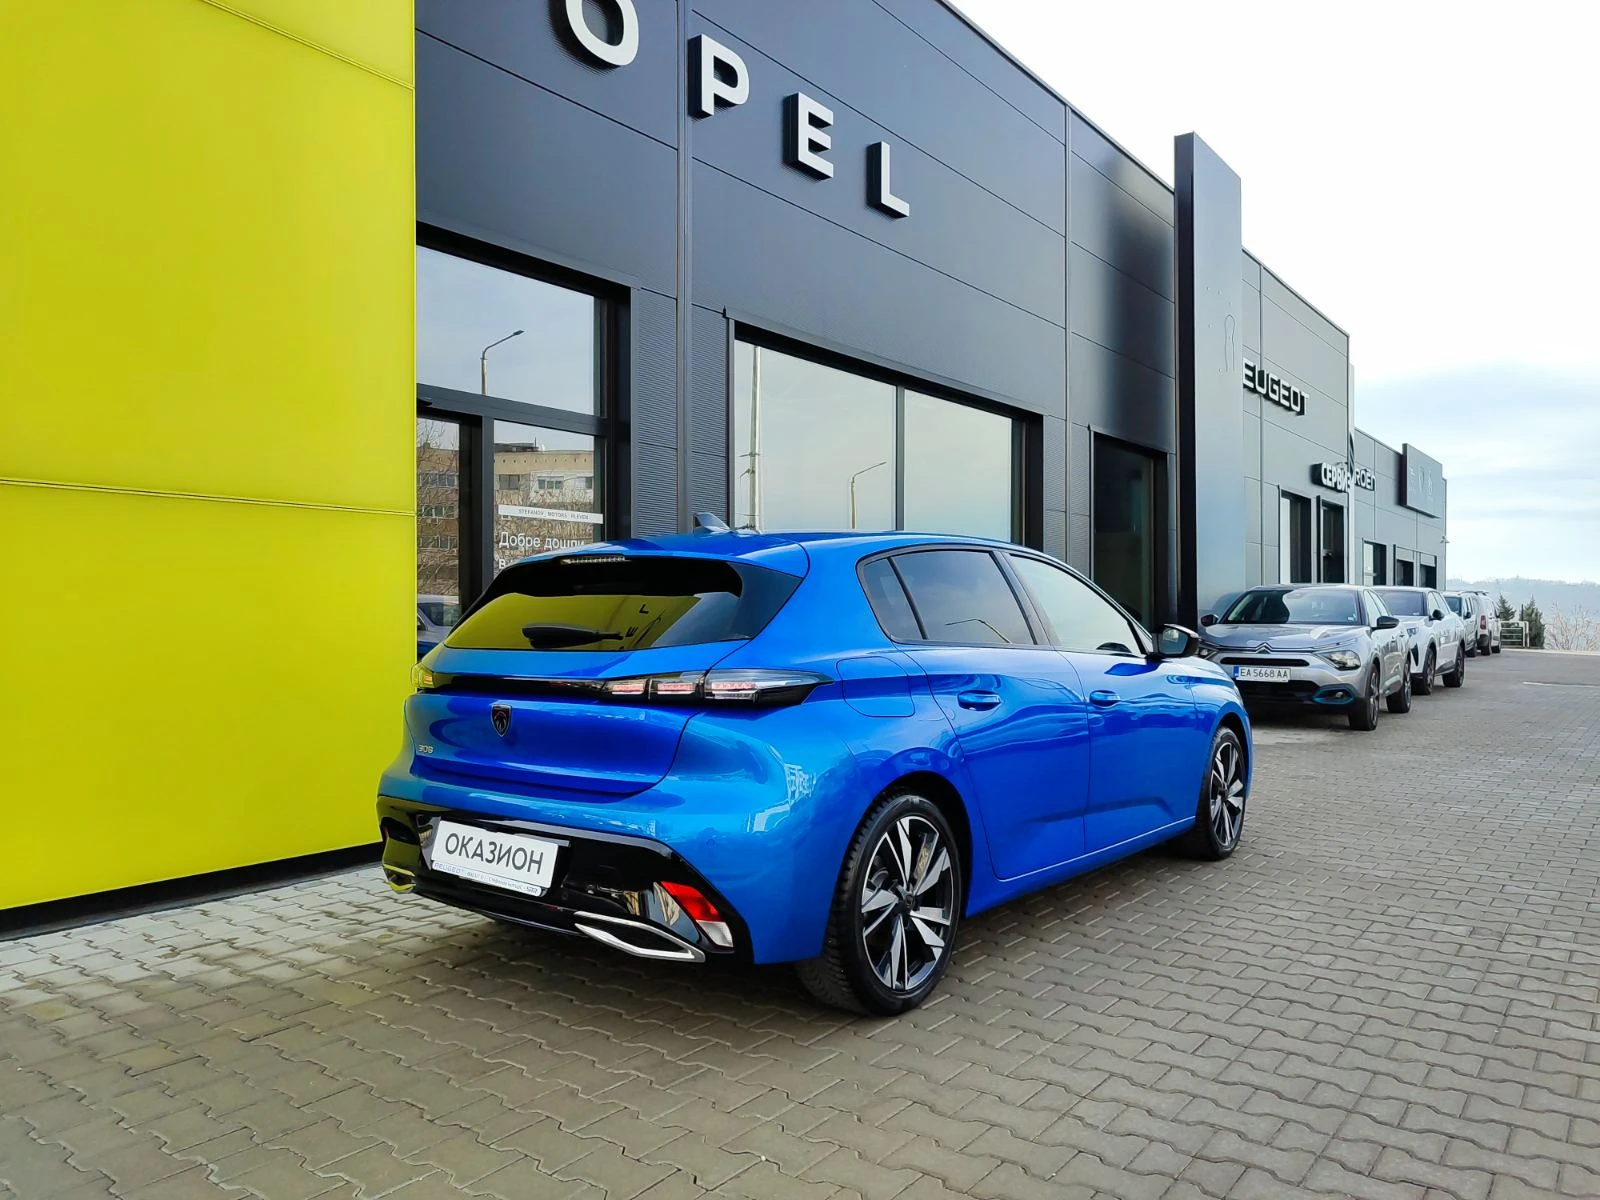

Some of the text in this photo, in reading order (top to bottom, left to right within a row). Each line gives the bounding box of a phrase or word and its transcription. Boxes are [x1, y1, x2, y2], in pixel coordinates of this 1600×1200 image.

[565, 0, 910, 218] OPEL
[1243, 357, 1309, 415] EUGEOT
[499, 531, 540, 553] Добре
[1240, 668, 1288, 679] EA 5668 AA
[418, 744, 434, 754] 308
[445, 832, 543, 875] ОКАЗИОН
